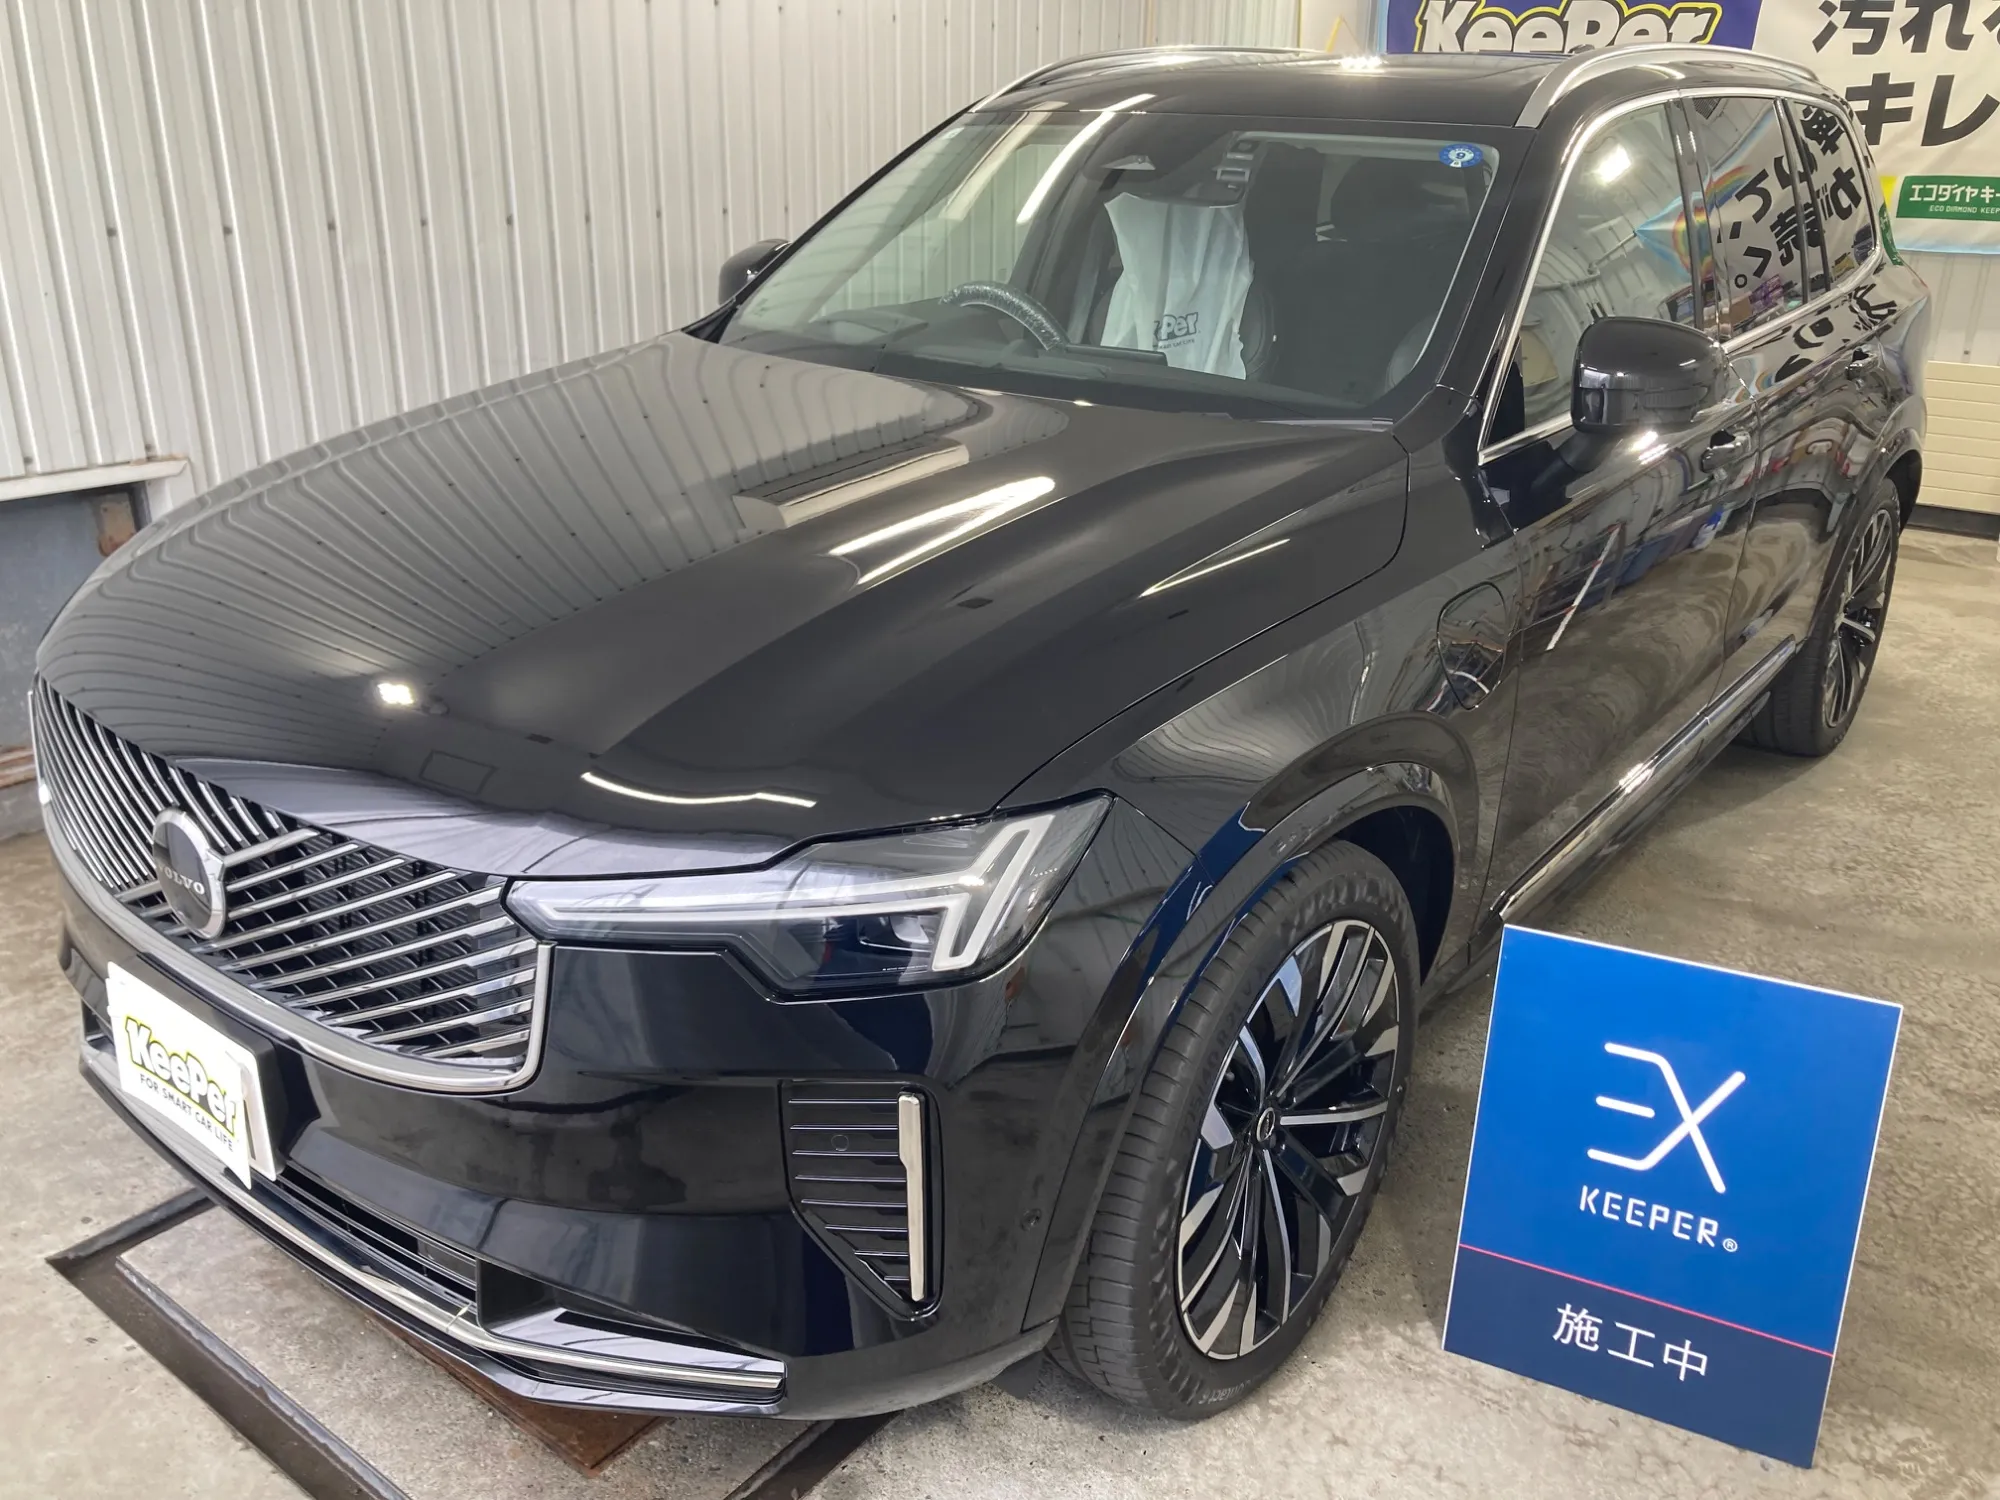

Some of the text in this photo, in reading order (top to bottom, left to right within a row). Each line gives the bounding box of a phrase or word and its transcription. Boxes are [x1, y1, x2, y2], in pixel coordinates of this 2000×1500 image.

[1422, 0, 1713, 54] KeePer
[125, 1016, 236, 1137] KeePer
[140, 1073, 234, 1152] FOR SMART CAR LIFE
[1552, 1303, 1708, 1382] 施工中
